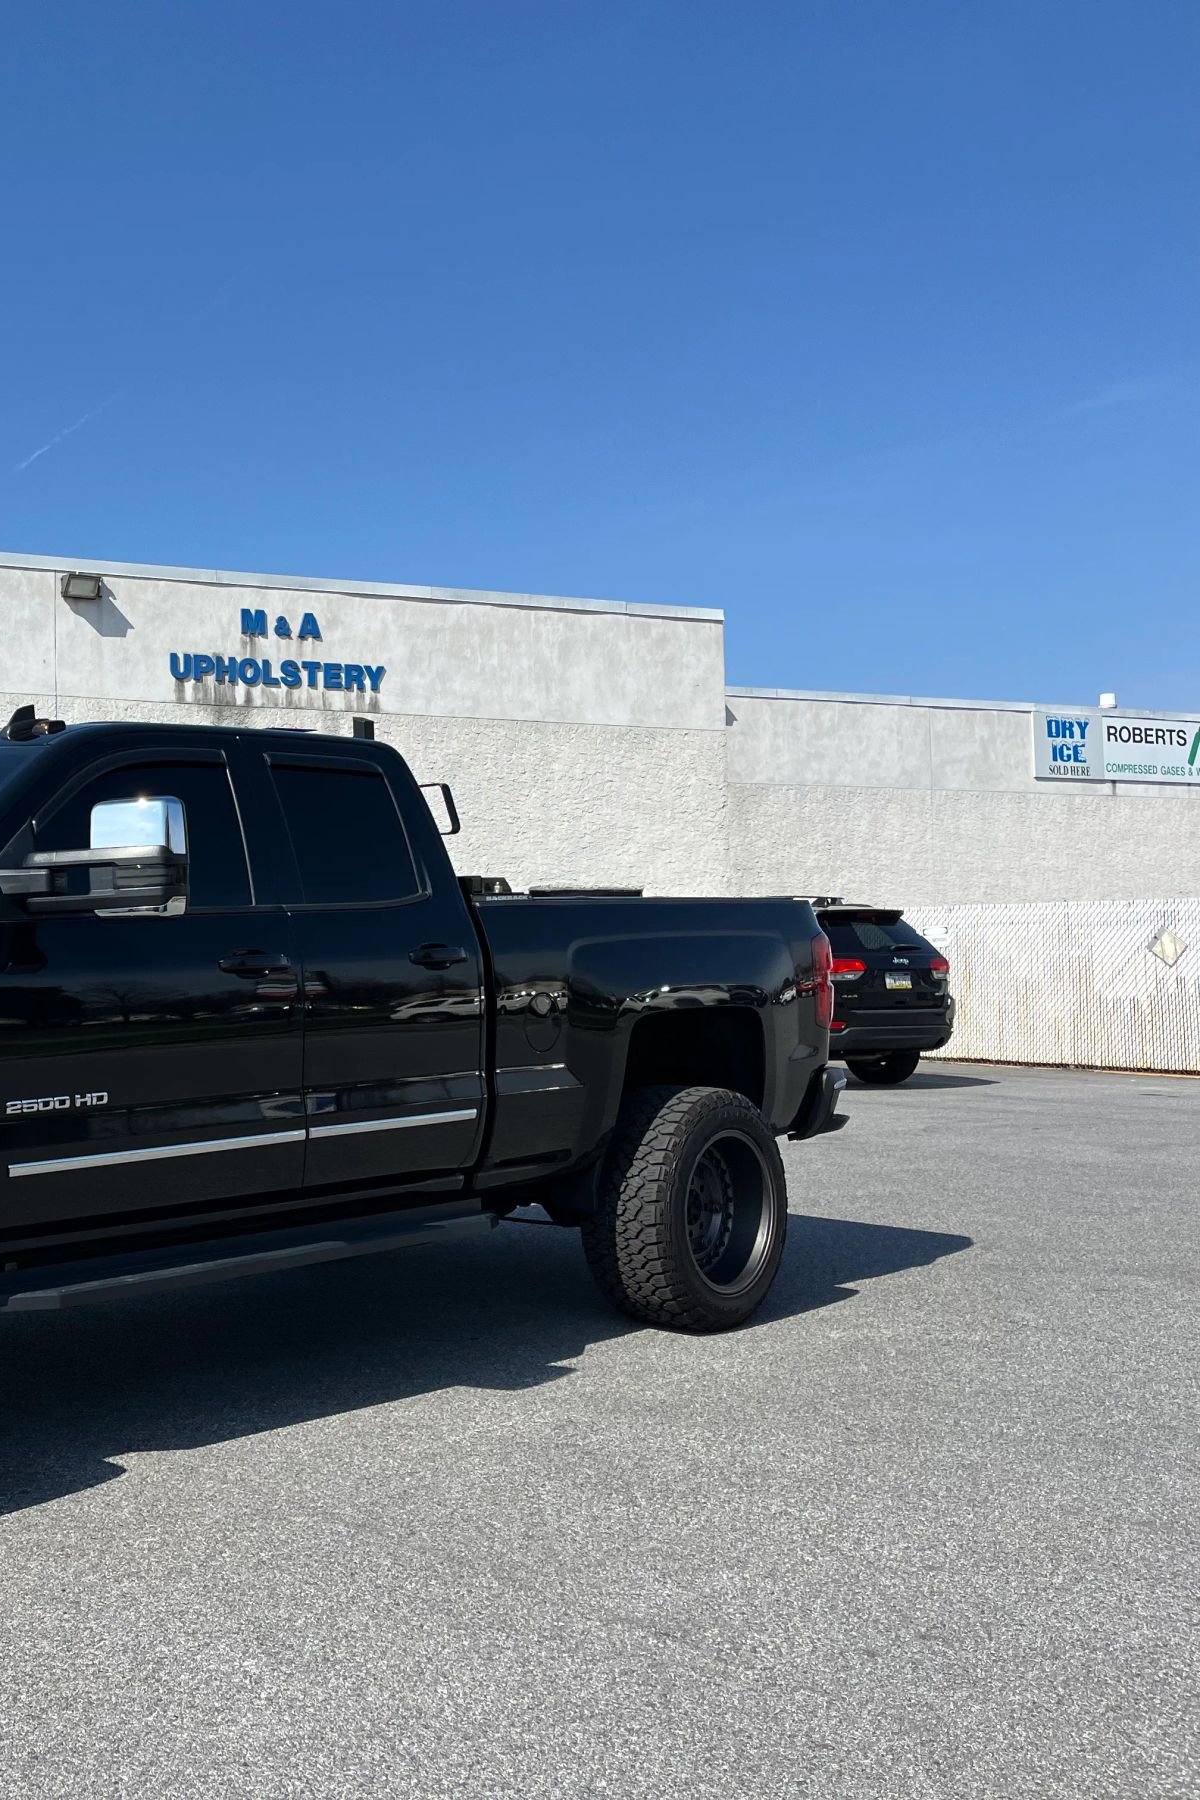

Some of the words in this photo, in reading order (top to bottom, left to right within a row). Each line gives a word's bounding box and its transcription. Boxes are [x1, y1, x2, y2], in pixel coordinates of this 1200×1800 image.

[240, 608, 268, 638] M
[274, 615, 292, 639] &
[298, 612, 323, 641] A
[169, 652, 386, 692] UPHOLSTERY
[1046, 716, 1089, 740] DRY
[1106, 725, 1188, 747] ROBERTS
[1051, 741, 1087, 763] ICE
[1048, 764, 1069, 776] SOLD
[1070, 765, 1091, 777] HERE
[1105, 762, 1158, 775] COMPRESSED
[1160, 765, 1186, 777] GASES
[892, 956, 910, 965] Jeep
[5, 1096, 71, 1115] 2500
[74, 1091, 109, 1108] HD
